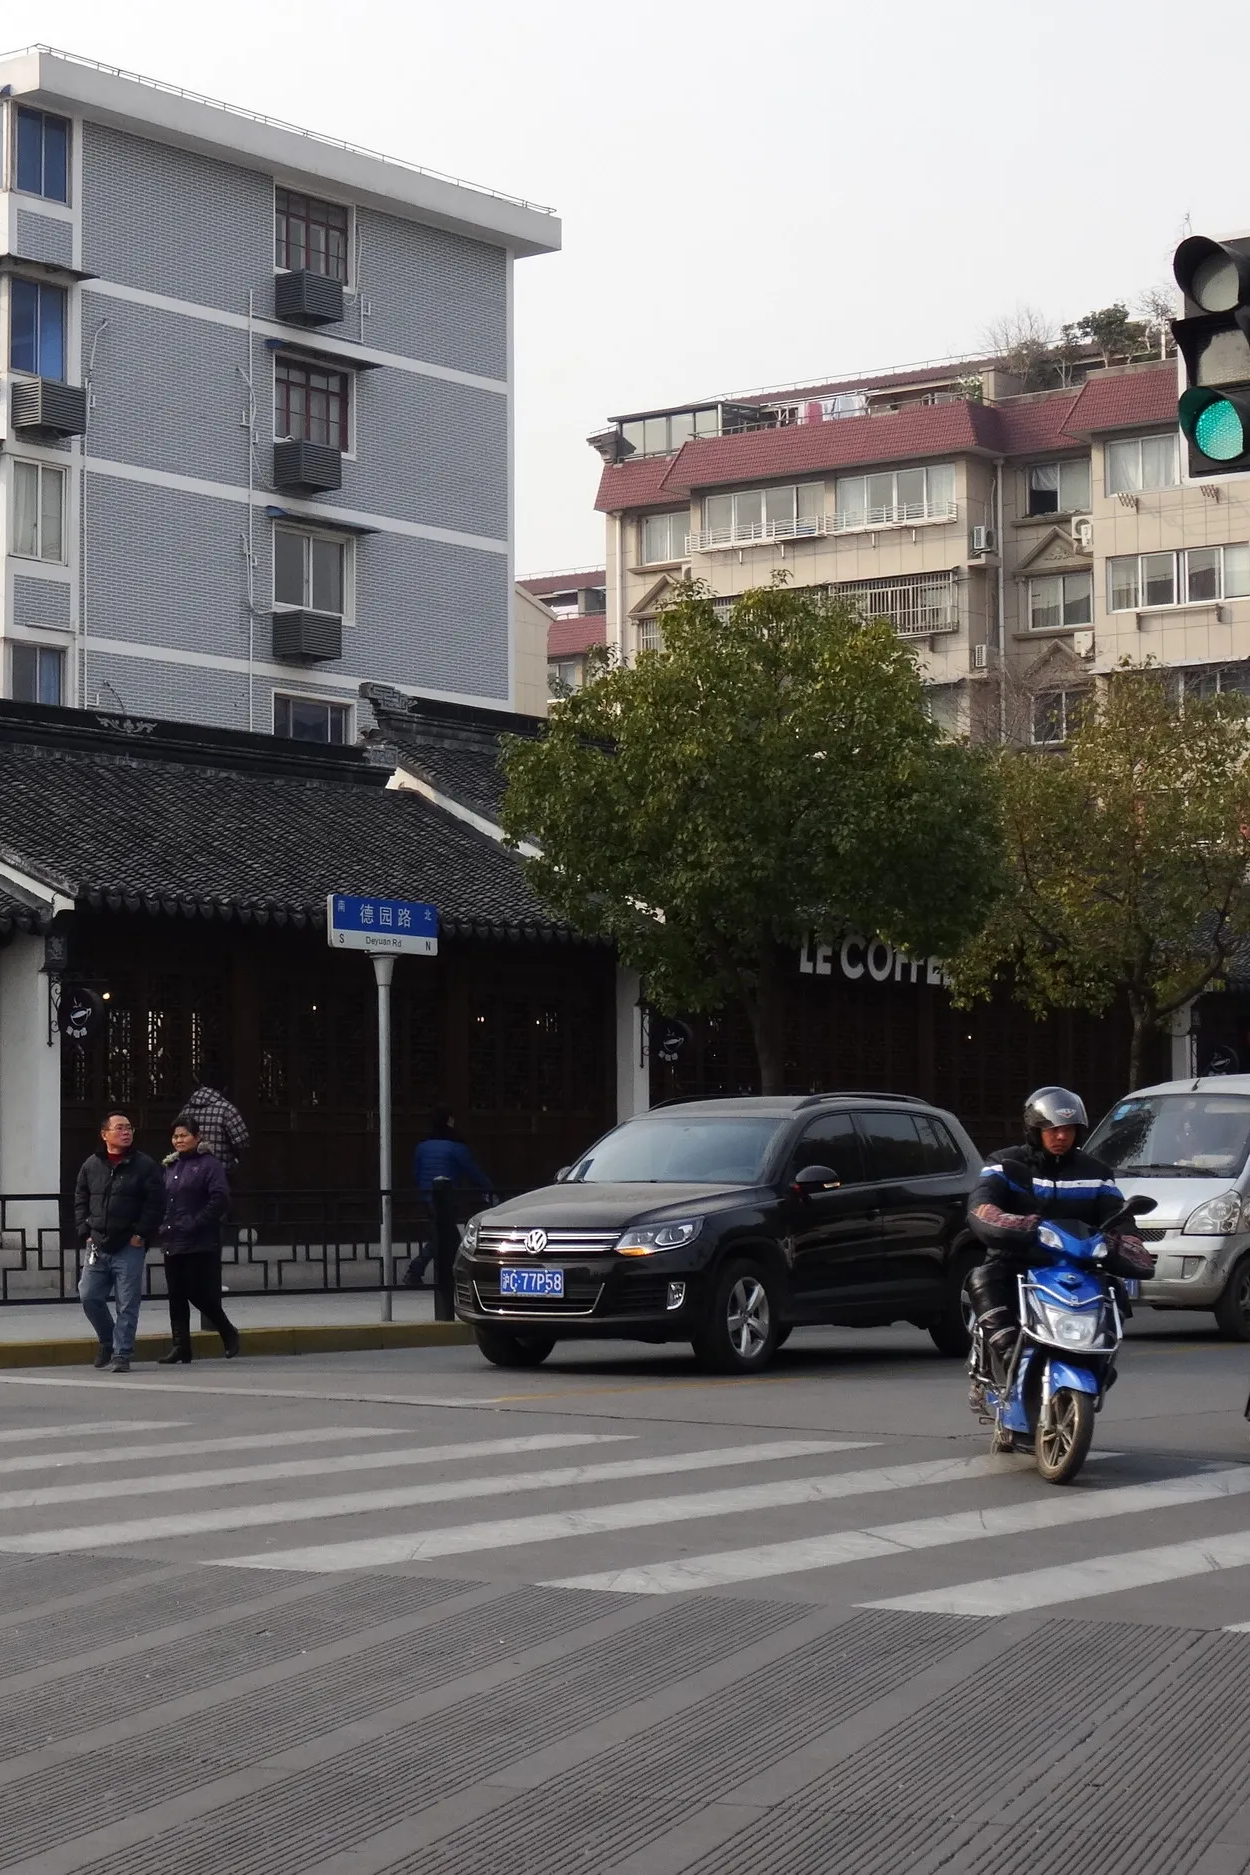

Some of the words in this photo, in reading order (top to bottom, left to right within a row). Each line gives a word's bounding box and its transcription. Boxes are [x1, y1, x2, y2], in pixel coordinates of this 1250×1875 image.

[337, 900, 346, 913] 南
[359, 904, 411, 928] 德园路
[424, 909, 432, 921] 北
[339, 933, 345, 944] S
[365, 936, 391, 947] Deyuan
[392, 938, 402, 948] Rd
[425, 940, 431, 952] N
[799, 934, 833, 976] LE
[839, 935, 956, 986] COFFE
